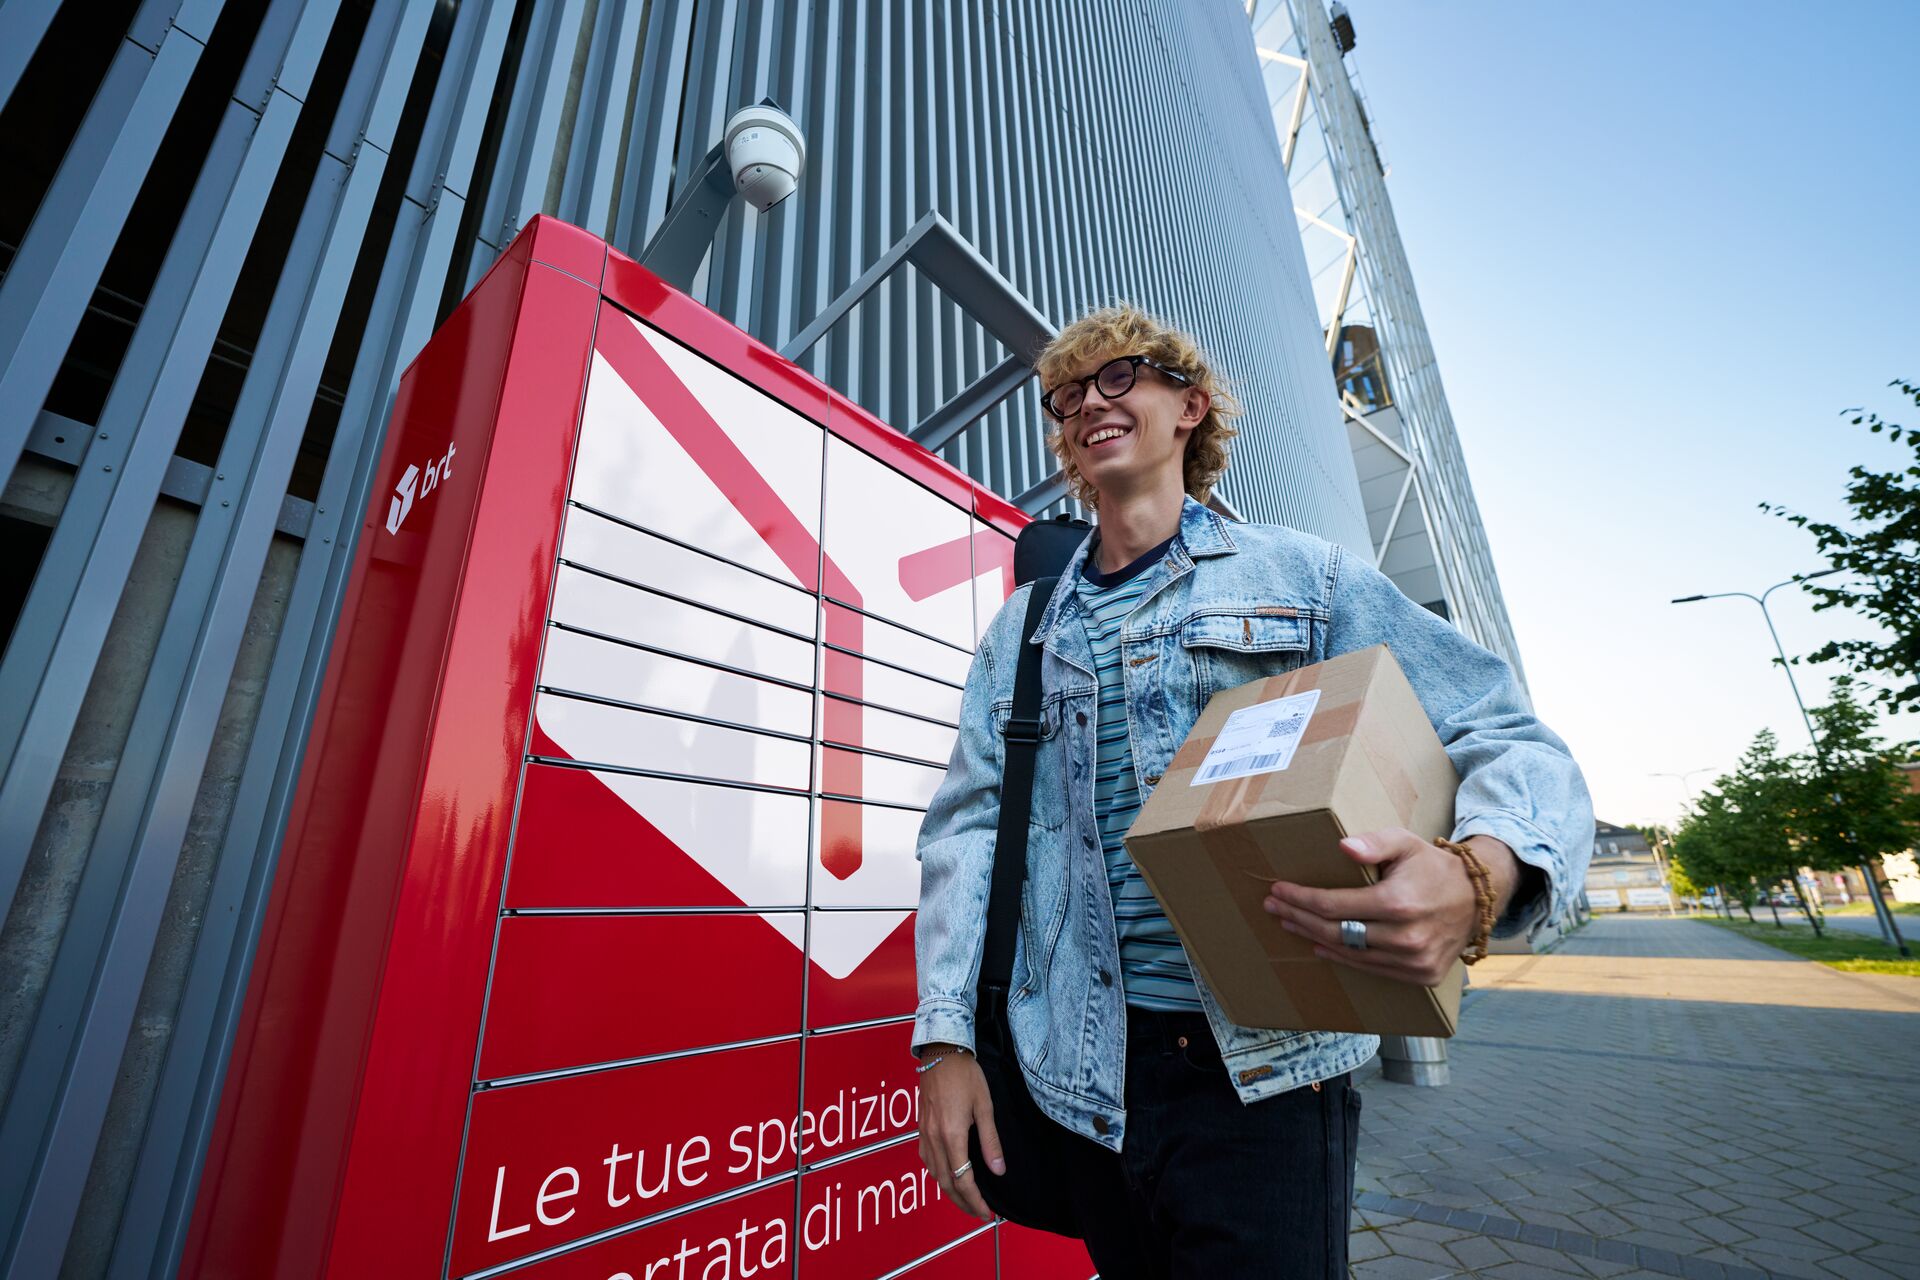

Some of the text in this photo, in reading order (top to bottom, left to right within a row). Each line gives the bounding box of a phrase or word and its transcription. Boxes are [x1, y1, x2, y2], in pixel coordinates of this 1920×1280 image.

[420, 441, 457, 499] brt
[487, 1080, 920, 1243] Le tue spedizio
[607, 1217, 787, 1280] rtata
[803, 1182, 842, 1251] di
